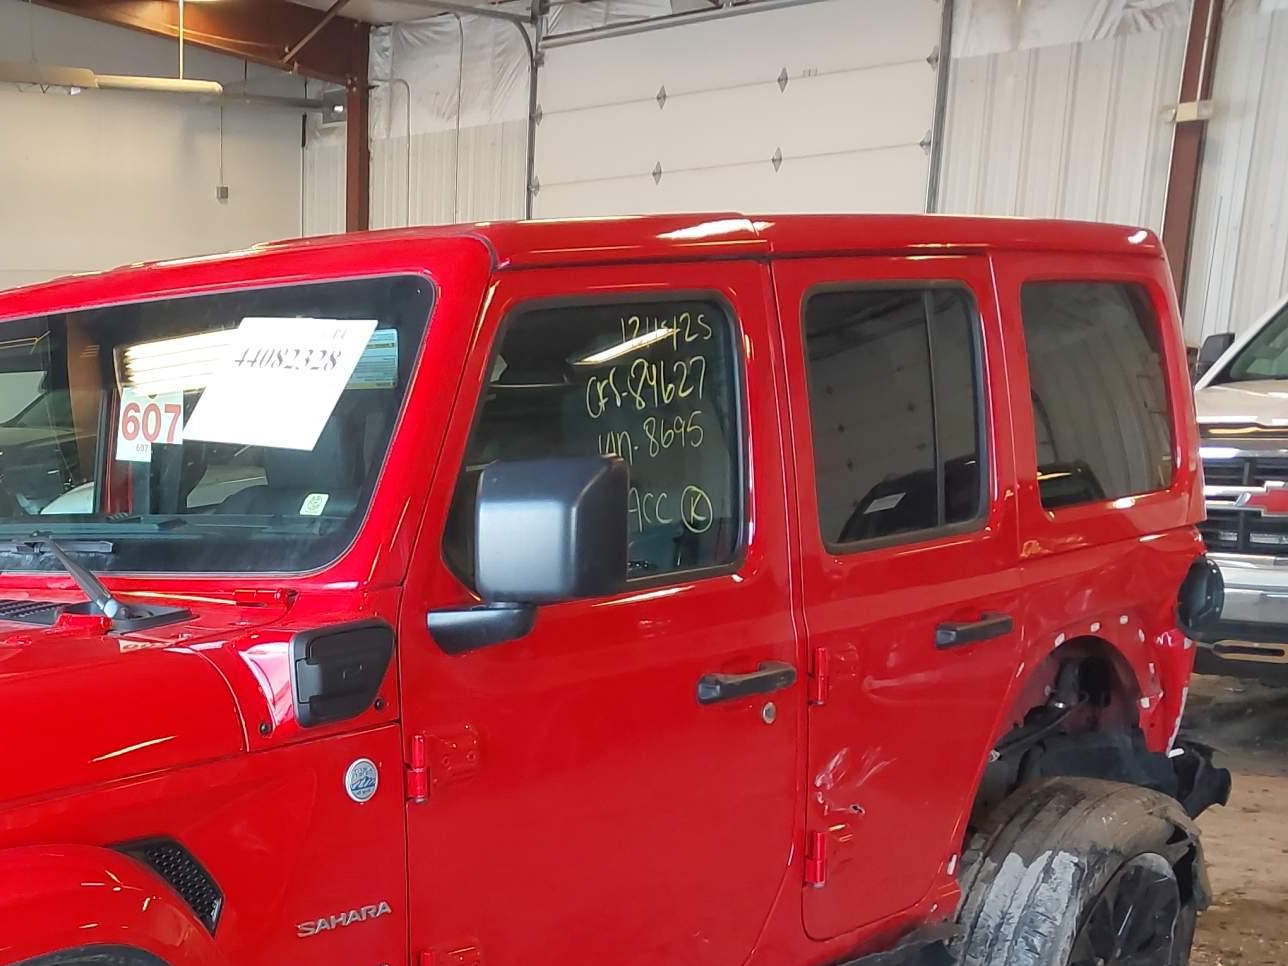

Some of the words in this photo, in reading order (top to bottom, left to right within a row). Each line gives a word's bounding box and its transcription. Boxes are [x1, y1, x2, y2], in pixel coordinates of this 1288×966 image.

[233, 347, 343, 372] 44082328
[121, 402, 182, 444] 607
[295, 900, 393, 938] SAHARA
